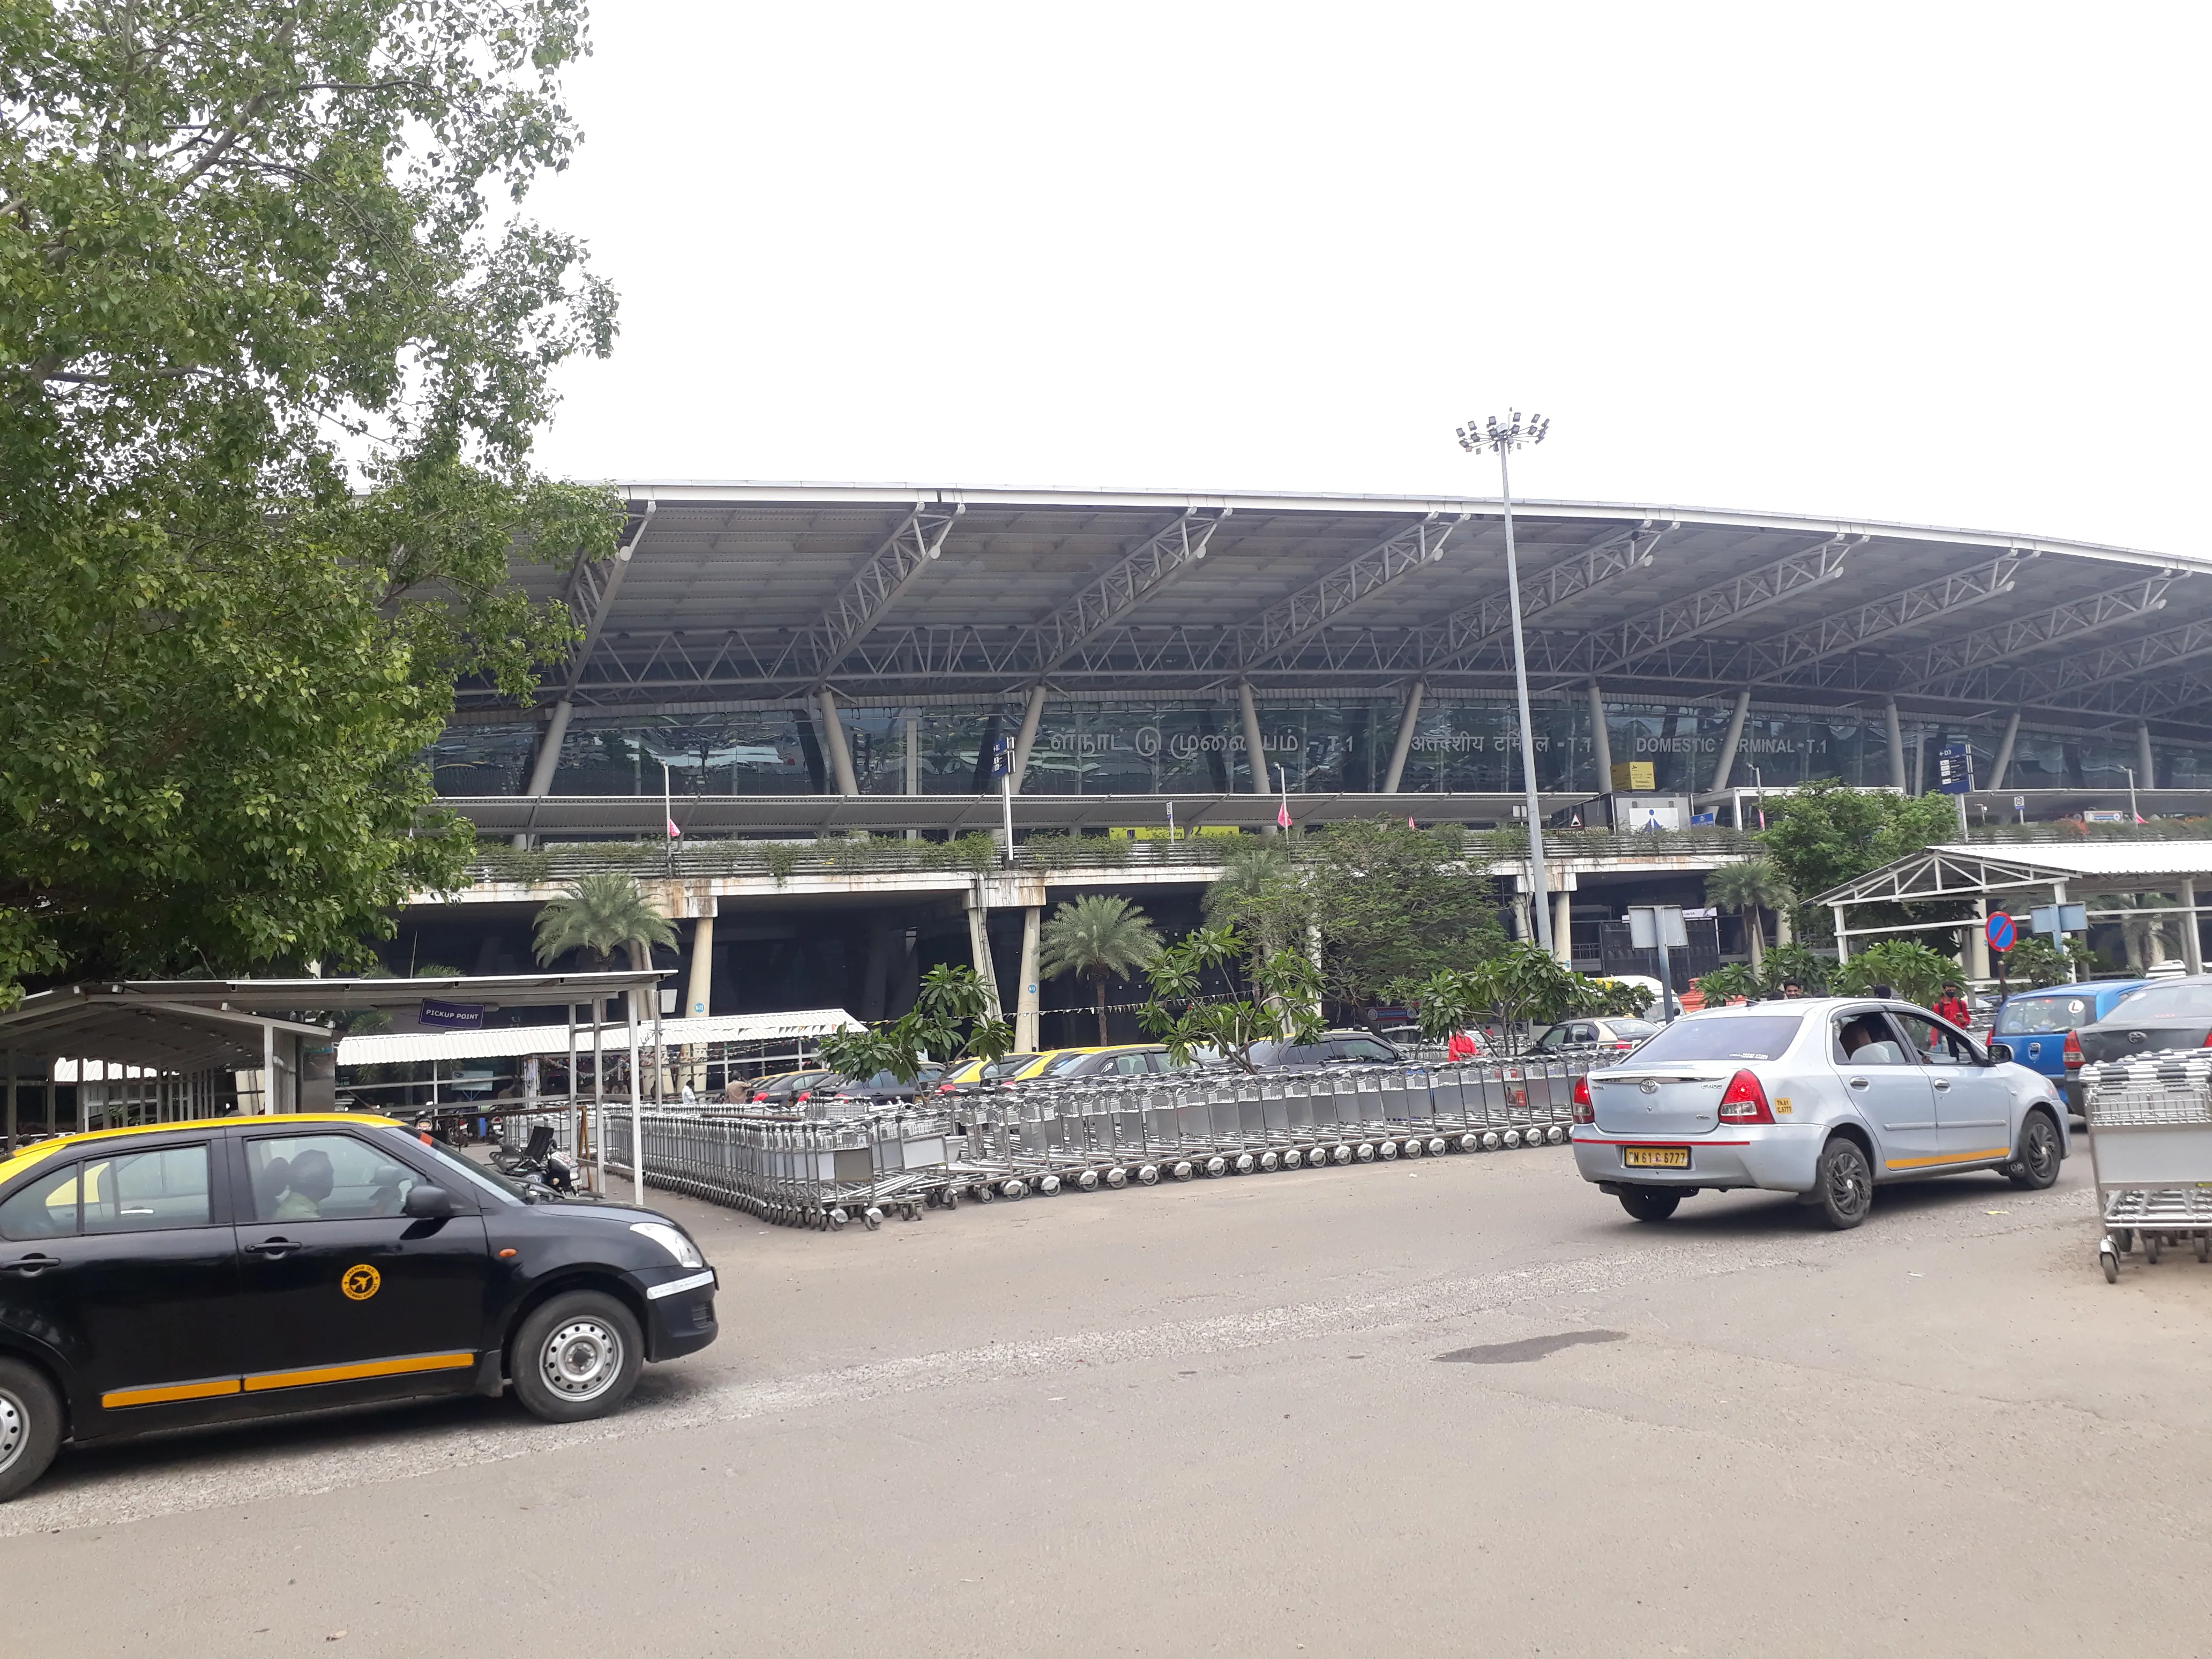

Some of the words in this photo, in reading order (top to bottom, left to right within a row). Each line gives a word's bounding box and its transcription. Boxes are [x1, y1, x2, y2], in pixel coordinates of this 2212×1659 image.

[1493, 731, 1550, 752] टर्मिल
[1635, 737, 1715, 753] DOMESTIC
[1719, 738, 1795, 753] RMINAL
[2071, 1002, 2080, 1011] L
[426, 1009, 455, 1018] PICKUP
[1642, 1152, 1651, 1163] 61
[1663, 1153, 1686, 1163] 6777
